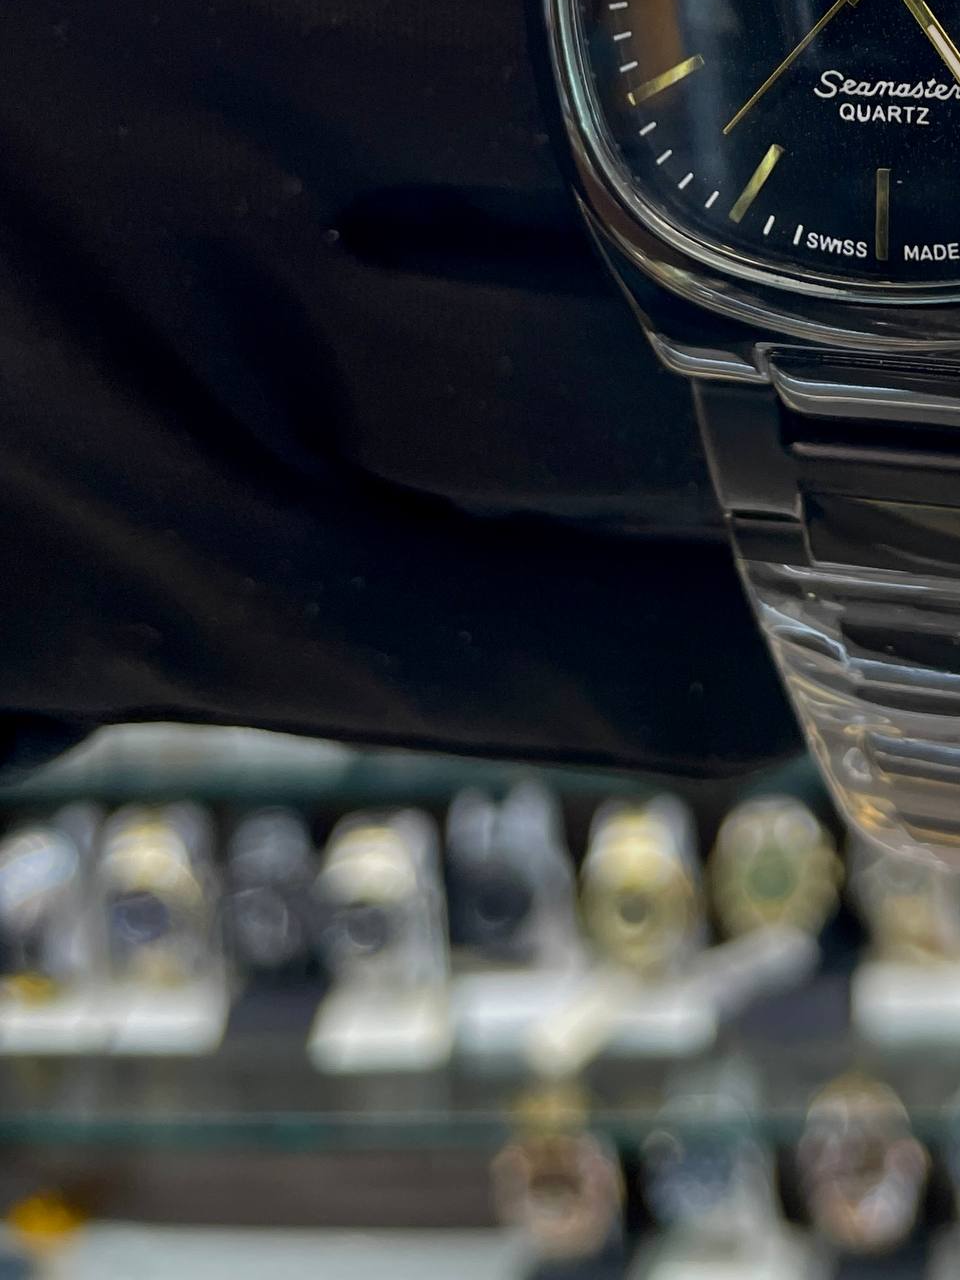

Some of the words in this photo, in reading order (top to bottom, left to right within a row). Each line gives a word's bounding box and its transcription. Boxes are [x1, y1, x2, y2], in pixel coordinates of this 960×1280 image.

[839, 103, 930, 125] QUARTZ
[806, 231, 868, 258] SWISS
[903, 242, 960, 261] MADE
